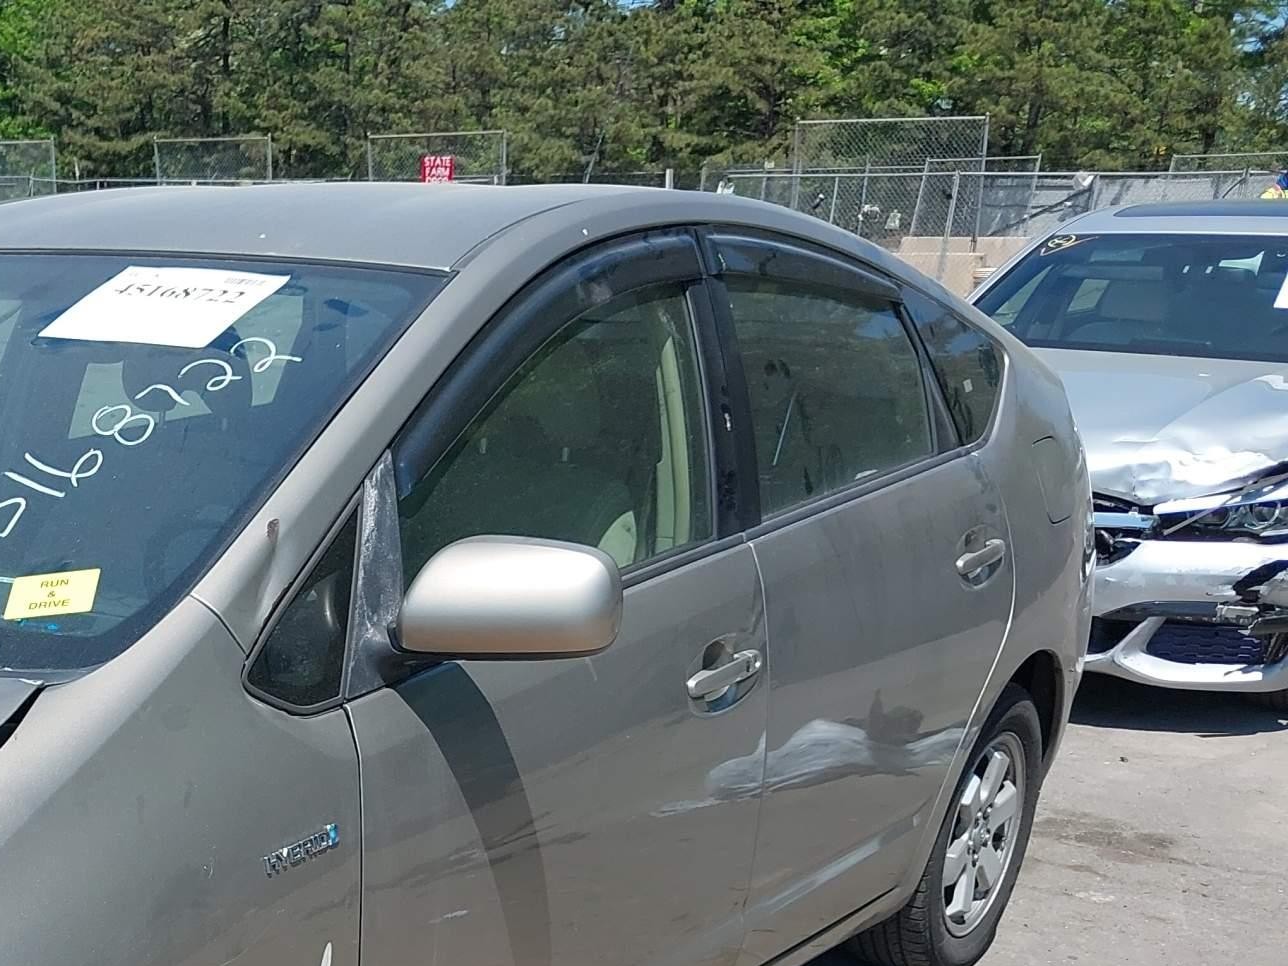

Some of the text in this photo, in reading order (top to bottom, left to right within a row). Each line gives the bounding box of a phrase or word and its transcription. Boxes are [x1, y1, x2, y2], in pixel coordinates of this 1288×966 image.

[424, 156, 452, 167] STATE
[424, 167, 450, 177] FARM
[114, 282, 246, 304] 45168722
[40, 579, 69, 589] RUN
[47, 590, 57, 598] &
[28, 598, 71, 610] DRIVE
